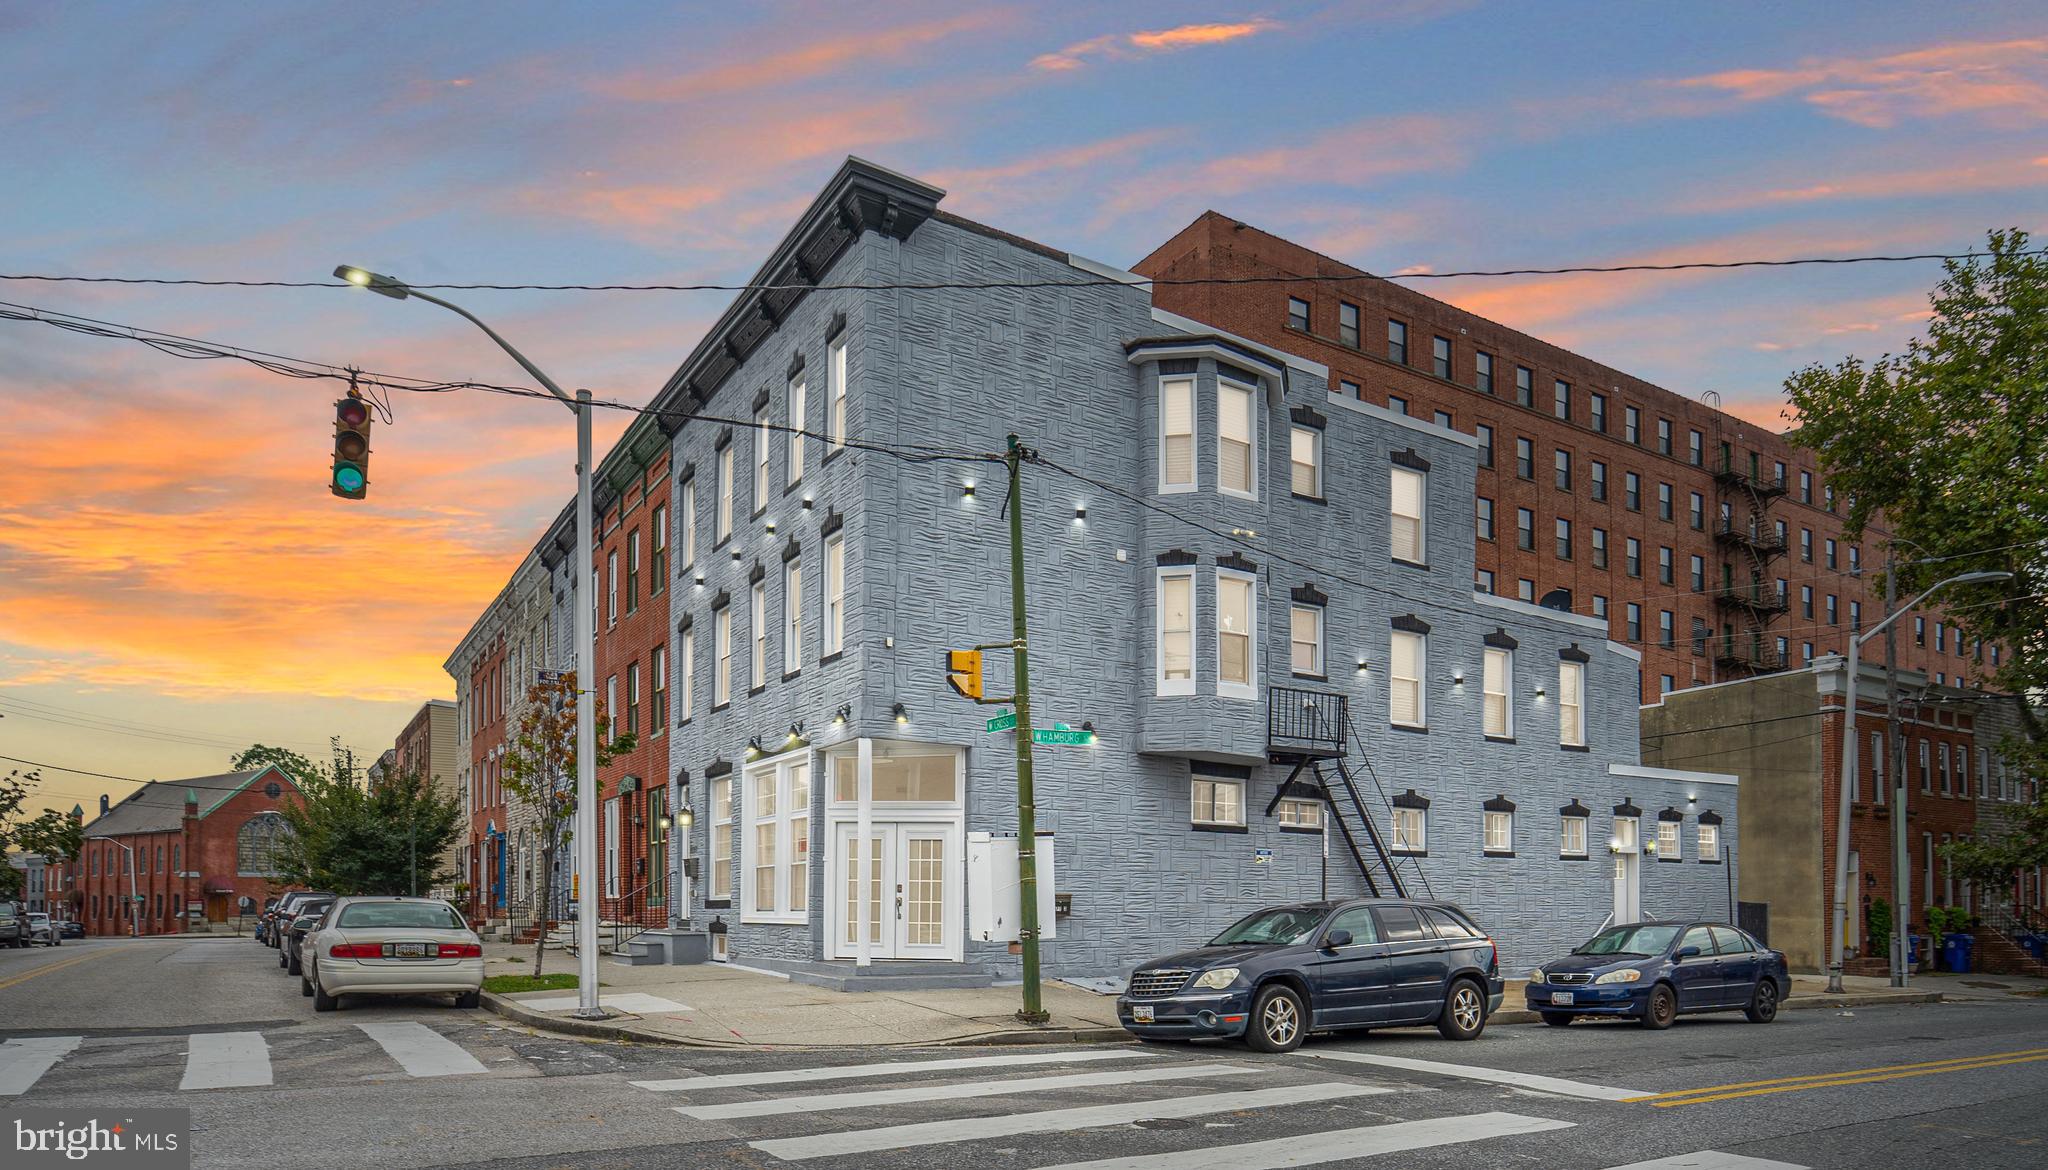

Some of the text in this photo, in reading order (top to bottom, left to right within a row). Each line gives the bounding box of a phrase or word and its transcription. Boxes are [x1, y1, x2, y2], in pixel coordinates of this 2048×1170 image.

[994, 717, 1009, 730] CROSS
[1035, 731, 1042, 741] W
[1043, 732, 1080, 743] HAMBURG
